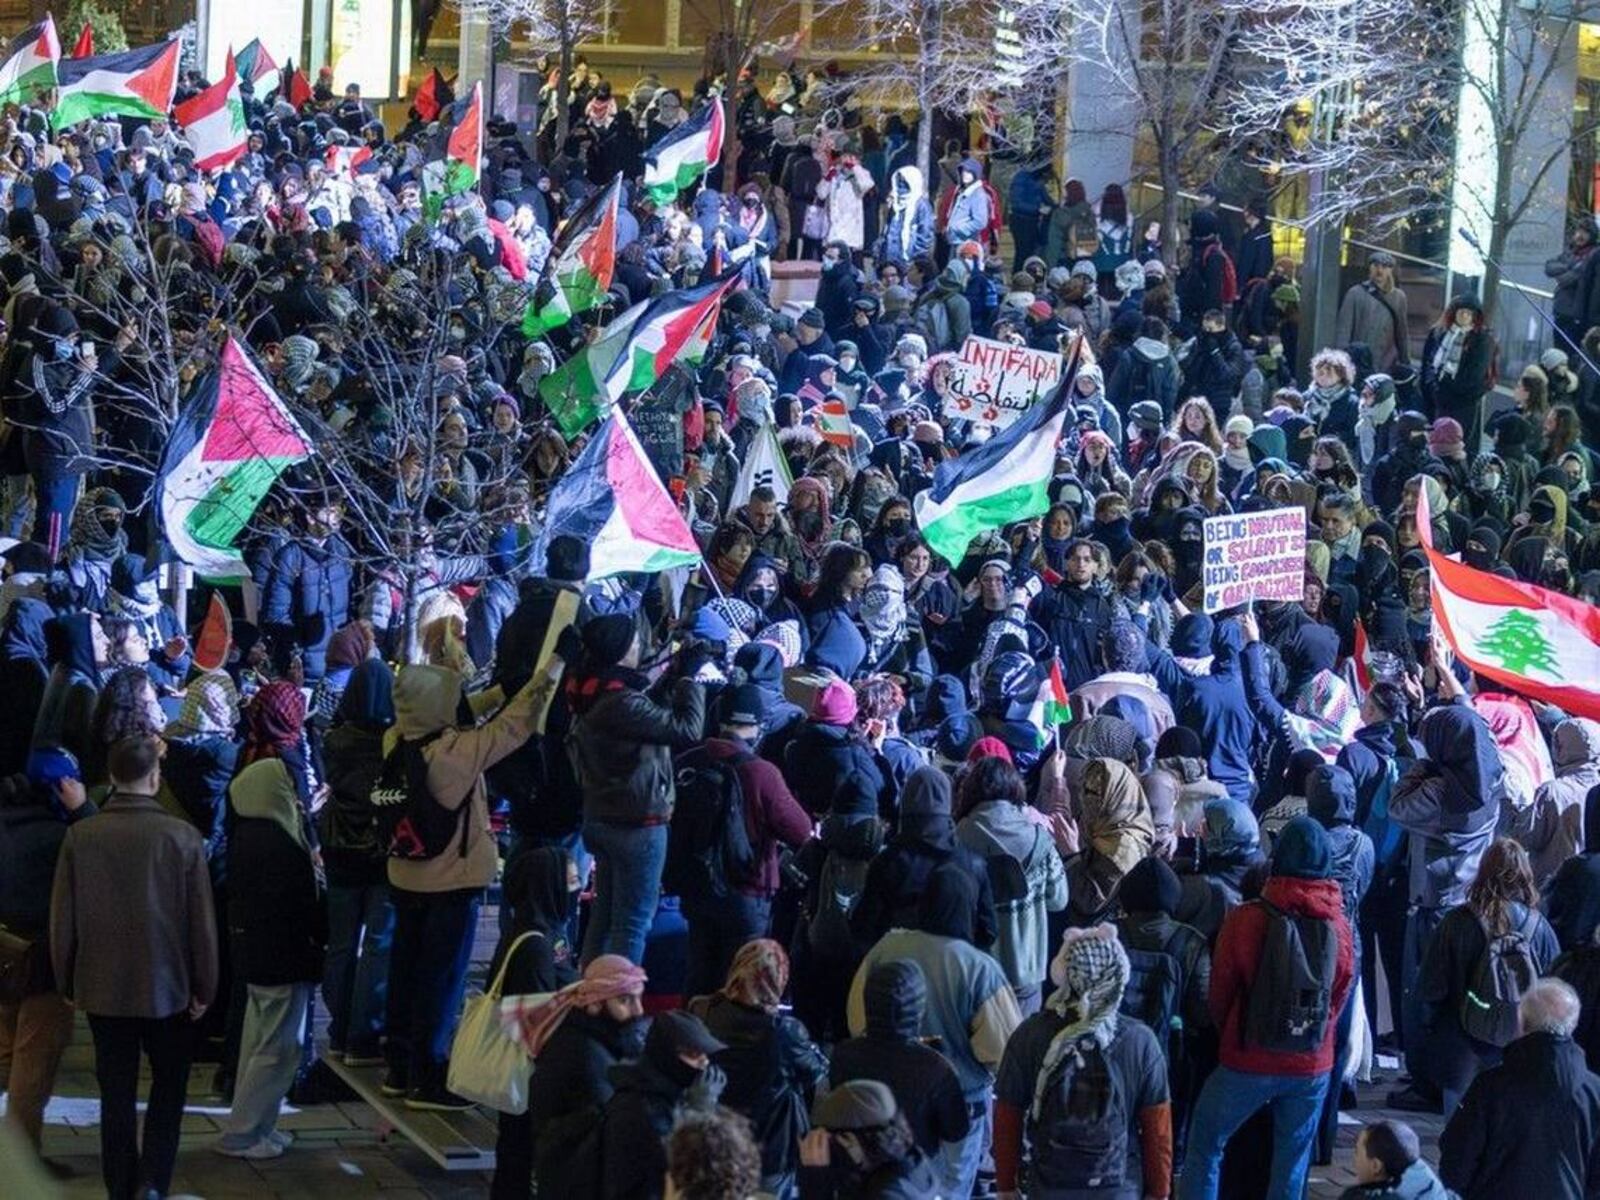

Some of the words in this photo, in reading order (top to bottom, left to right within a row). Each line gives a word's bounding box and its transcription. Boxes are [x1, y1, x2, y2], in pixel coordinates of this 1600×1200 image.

[958, 339, 1057, 382] INTIFADA
[1205, 519, 1247, 542] BEING
[1247, 512, 1304, 537] NEUTRAL
[1206, 547, 1223, 565] OR
[1227, 535, 1288, 563] SILENT
[1205, 564, 1239, 586] BEING
[1206, 590, 1220, 609] OF
